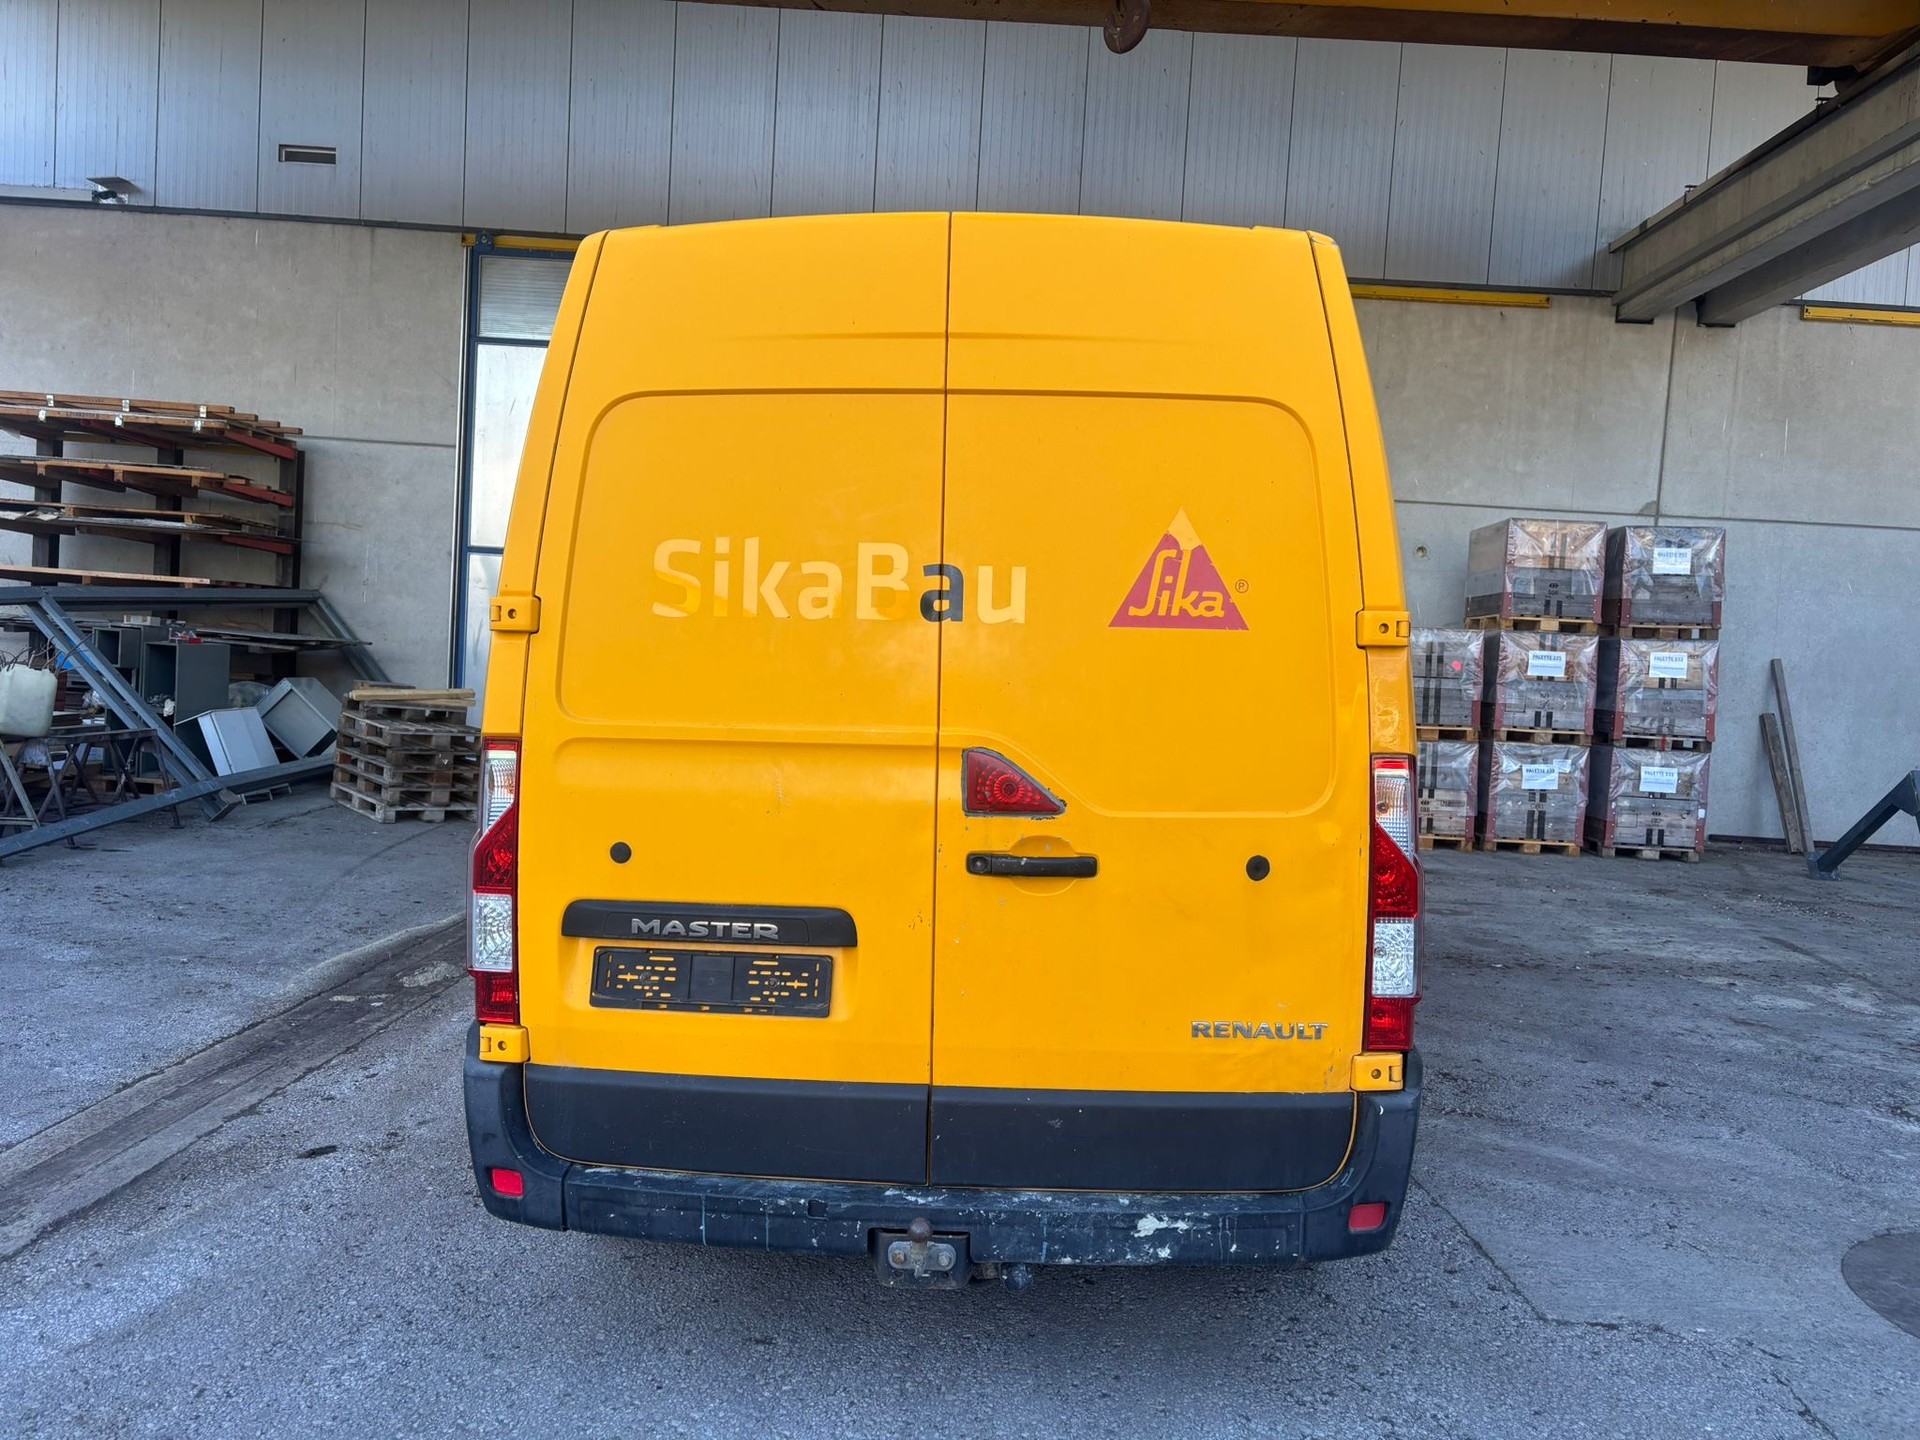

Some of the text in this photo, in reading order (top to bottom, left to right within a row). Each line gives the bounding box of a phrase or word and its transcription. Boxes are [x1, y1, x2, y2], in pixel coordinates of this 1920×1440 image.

[652, 536, 1027, 624] SikaBau
[1128, 549, 1225, 617] Sika
[631, 918, 779, 940] MASTER
[1191, 1020, 1328, 1040] RENAULT
